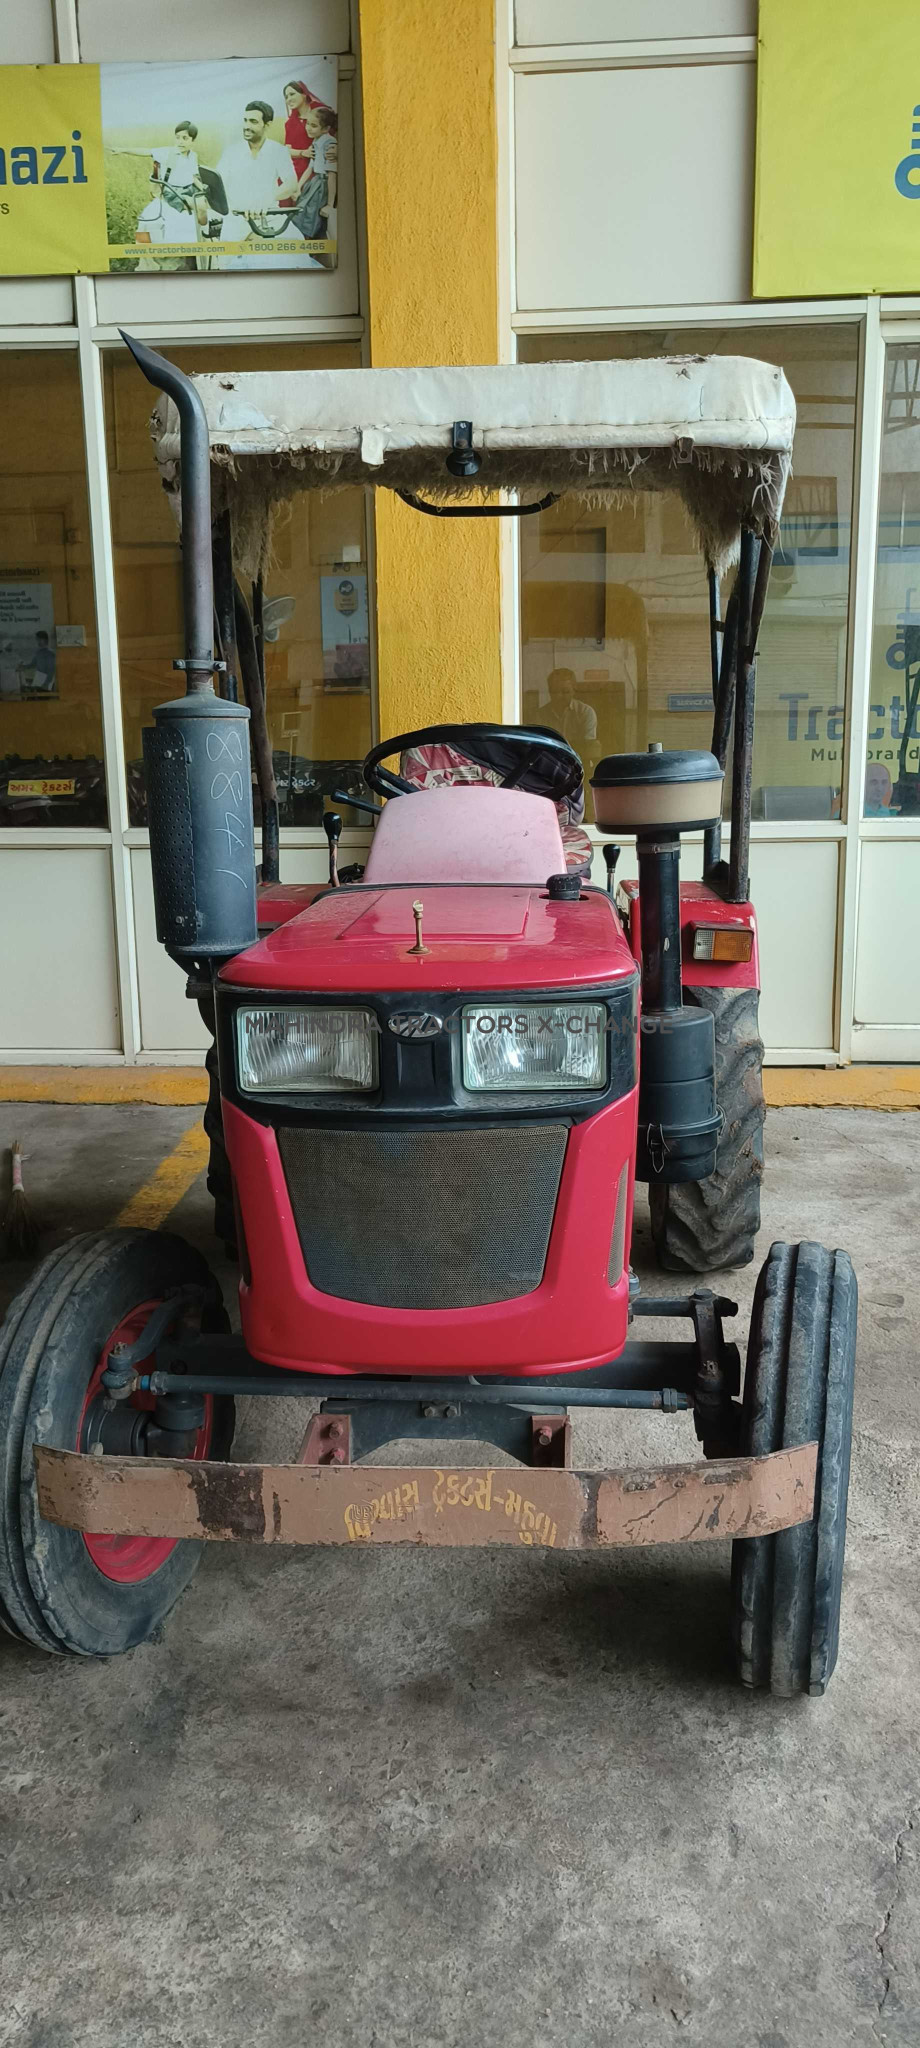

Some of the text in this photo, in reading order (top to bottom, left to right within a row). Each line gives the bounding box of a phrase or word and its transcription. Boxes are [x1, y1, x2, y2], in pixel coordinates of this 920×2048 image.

[0, 130, 88, 185] azi
[125, 245, 225, 255] www.tractorbaazi.com
[248, 242, 325, 251] 1800 266 4466
